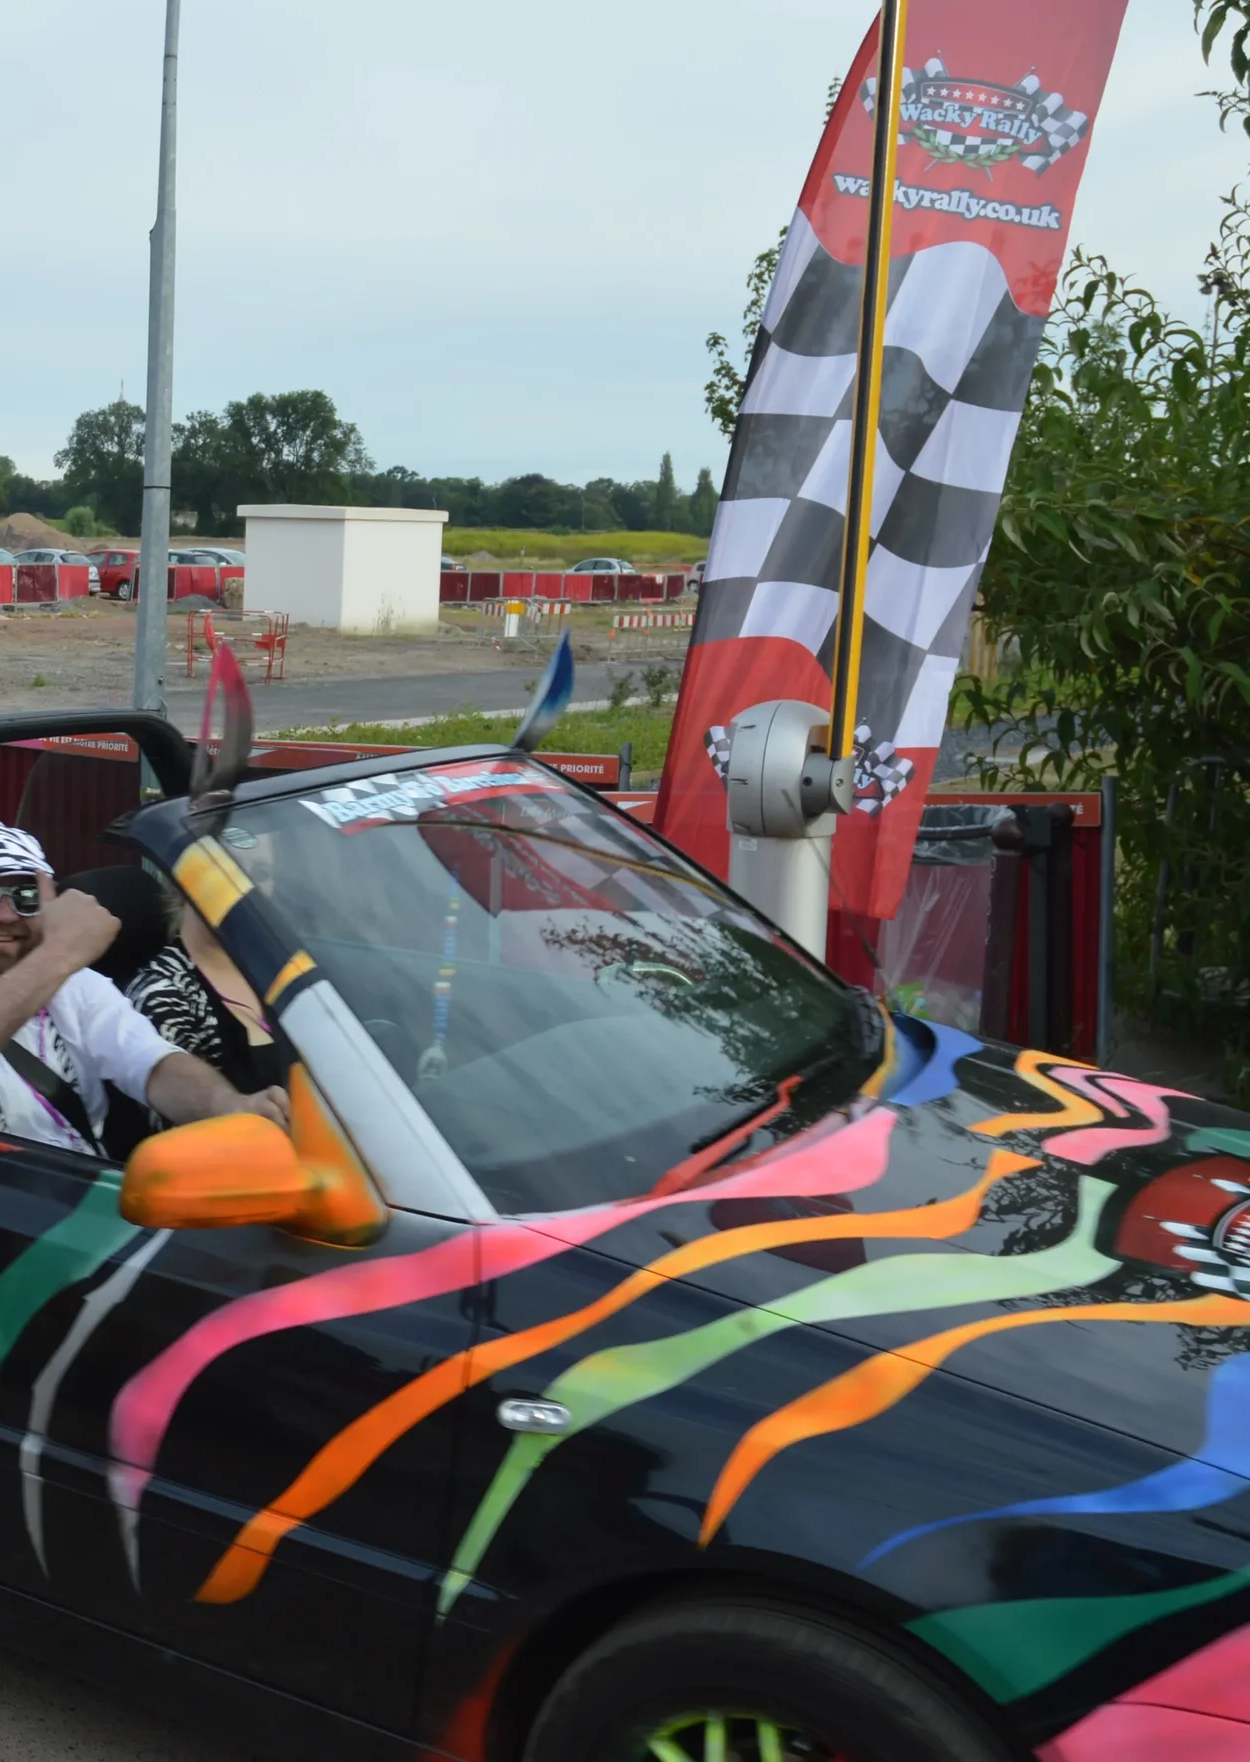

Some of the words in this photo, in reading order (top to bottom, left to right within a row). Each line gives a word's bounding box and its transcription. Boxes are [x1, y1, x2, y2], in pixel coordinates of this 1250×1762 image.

[899, 100, 978, 130] Wacky
[981, 109, 1044, 145] Rally
[833, 174, 1061, 230] wakyrally.co.uk
[560, 763, 605, 775] PRIORITÉ
